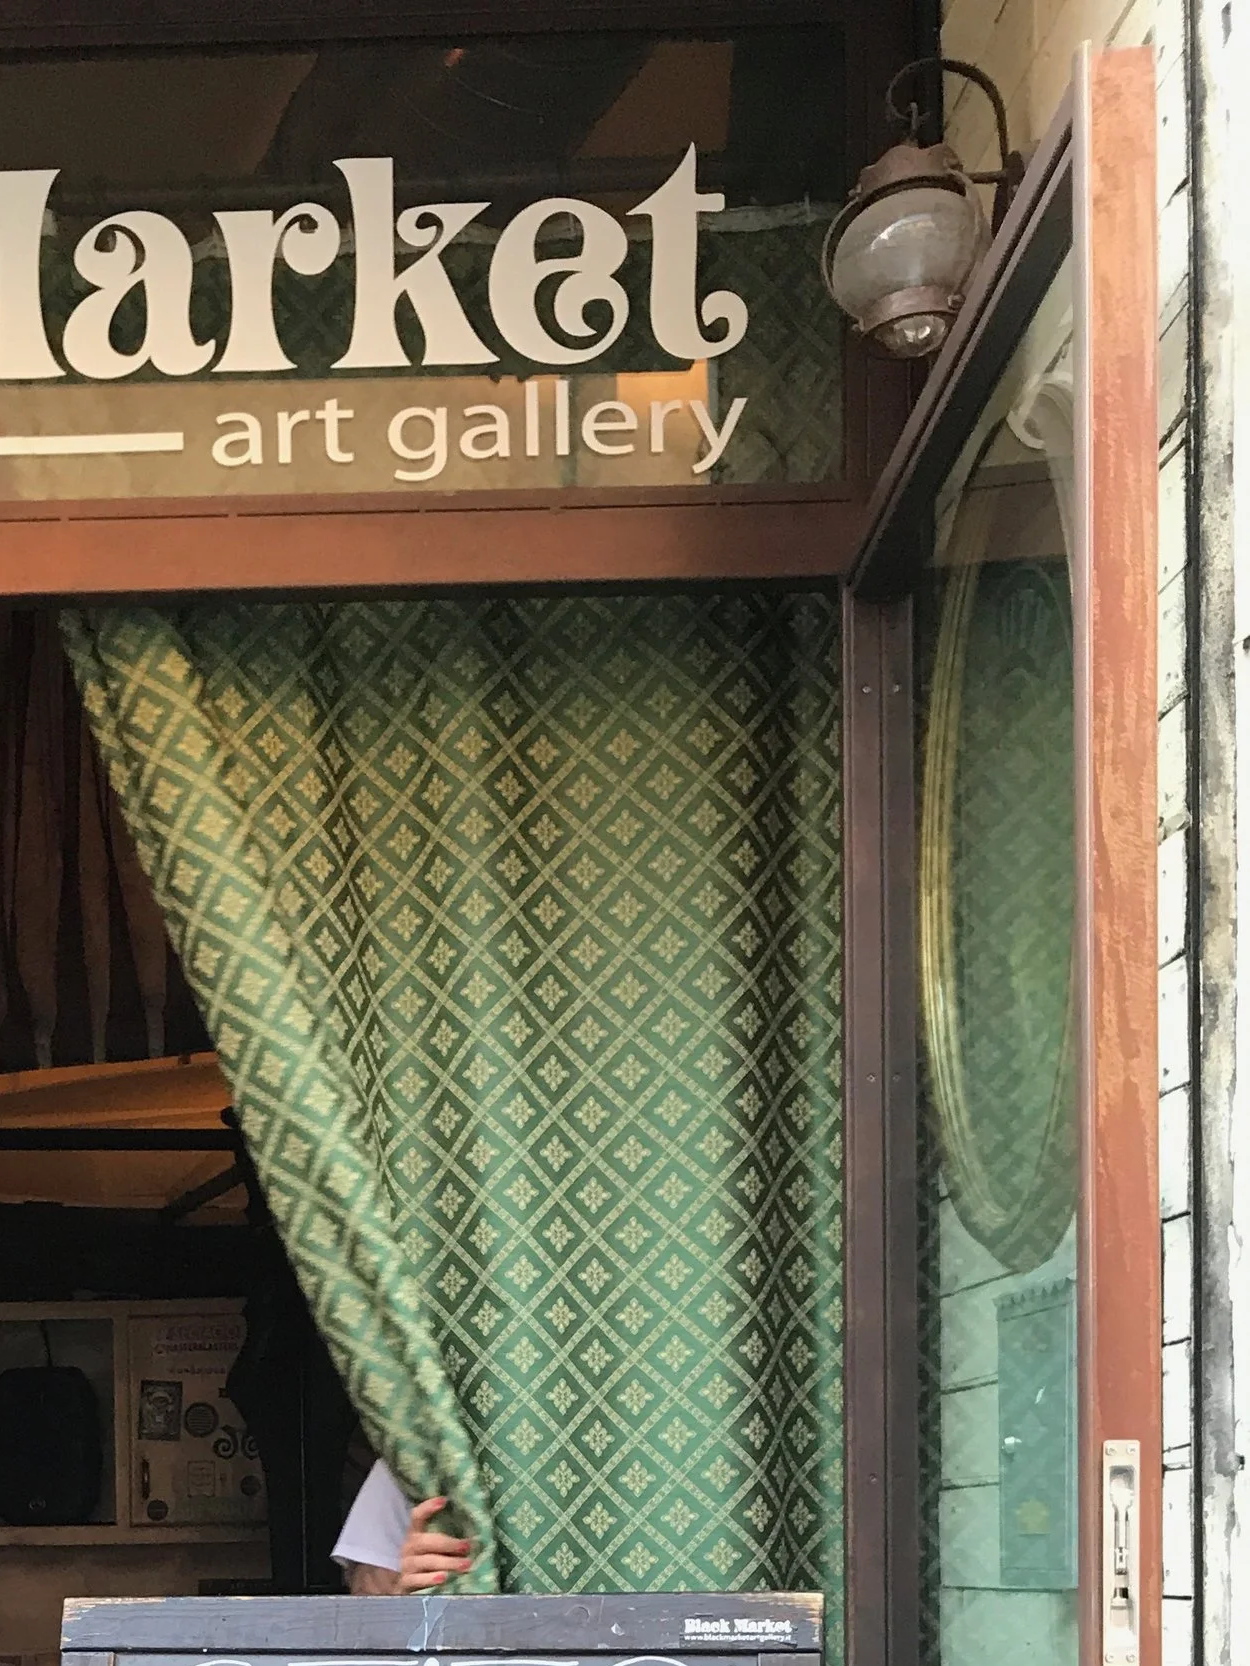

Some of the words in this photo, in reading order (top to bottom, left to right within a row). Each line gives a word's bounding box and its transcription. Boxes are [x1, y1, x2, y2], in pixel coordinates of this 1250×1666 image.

[212, 399, 354, 466] art
[388, 382, 746, 482] gallery
[684, 1618, 731, 1634] Black
[733, 1618, 792, 1634] Market
